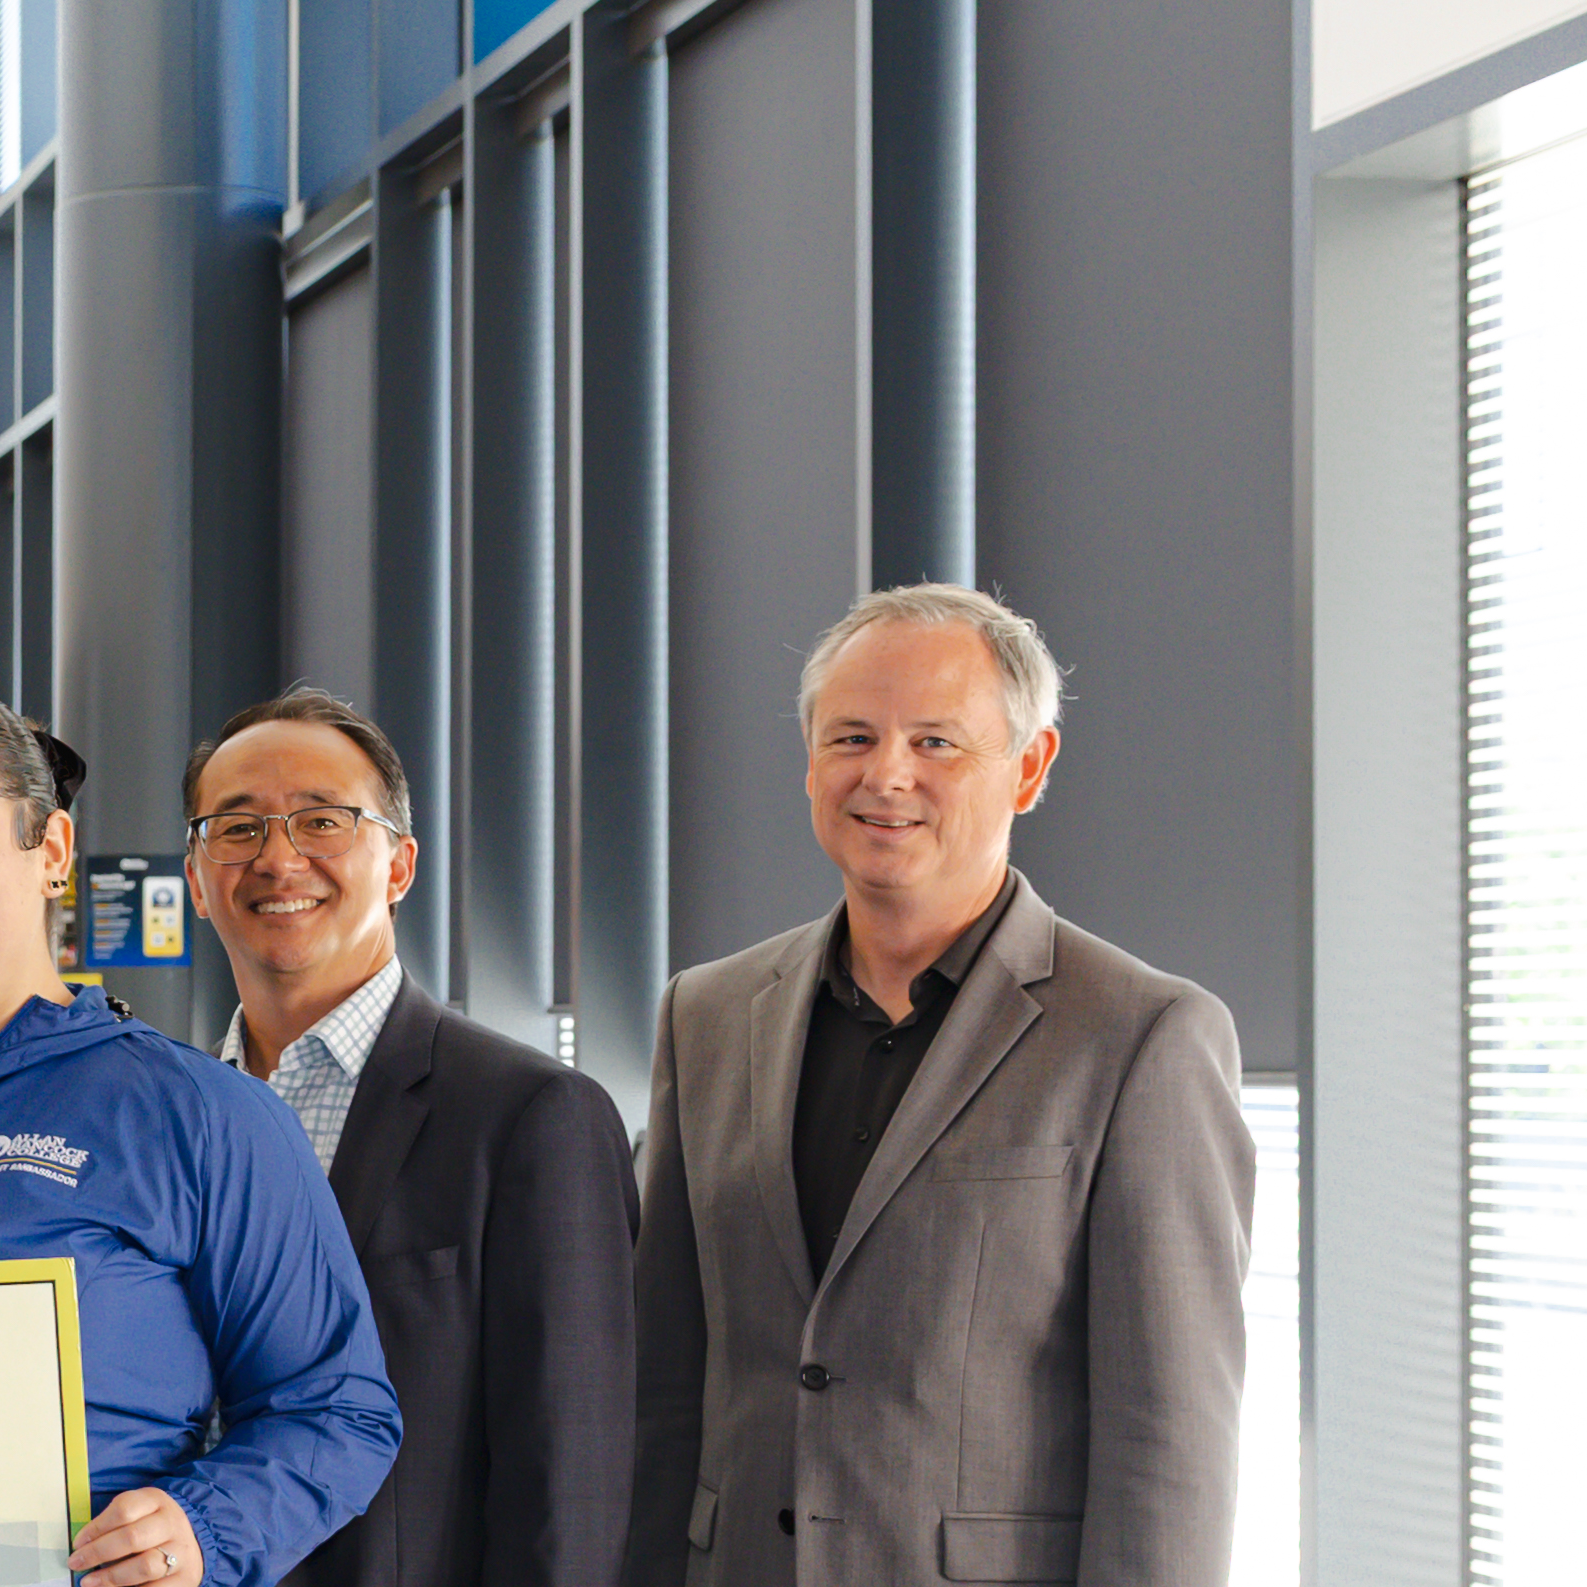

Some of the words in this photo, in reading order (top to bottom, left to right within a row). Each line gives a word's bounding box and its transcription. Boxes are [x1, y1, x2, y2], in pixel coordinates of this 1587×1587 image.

[10, 1138, 89, 1161] HANCOCK
[12, 1133, 66, 1146] ALLAN
[7, 1147, 82, 1168] COLLEGE
[10, 1163, 78, 1188] AMBASSADOR
